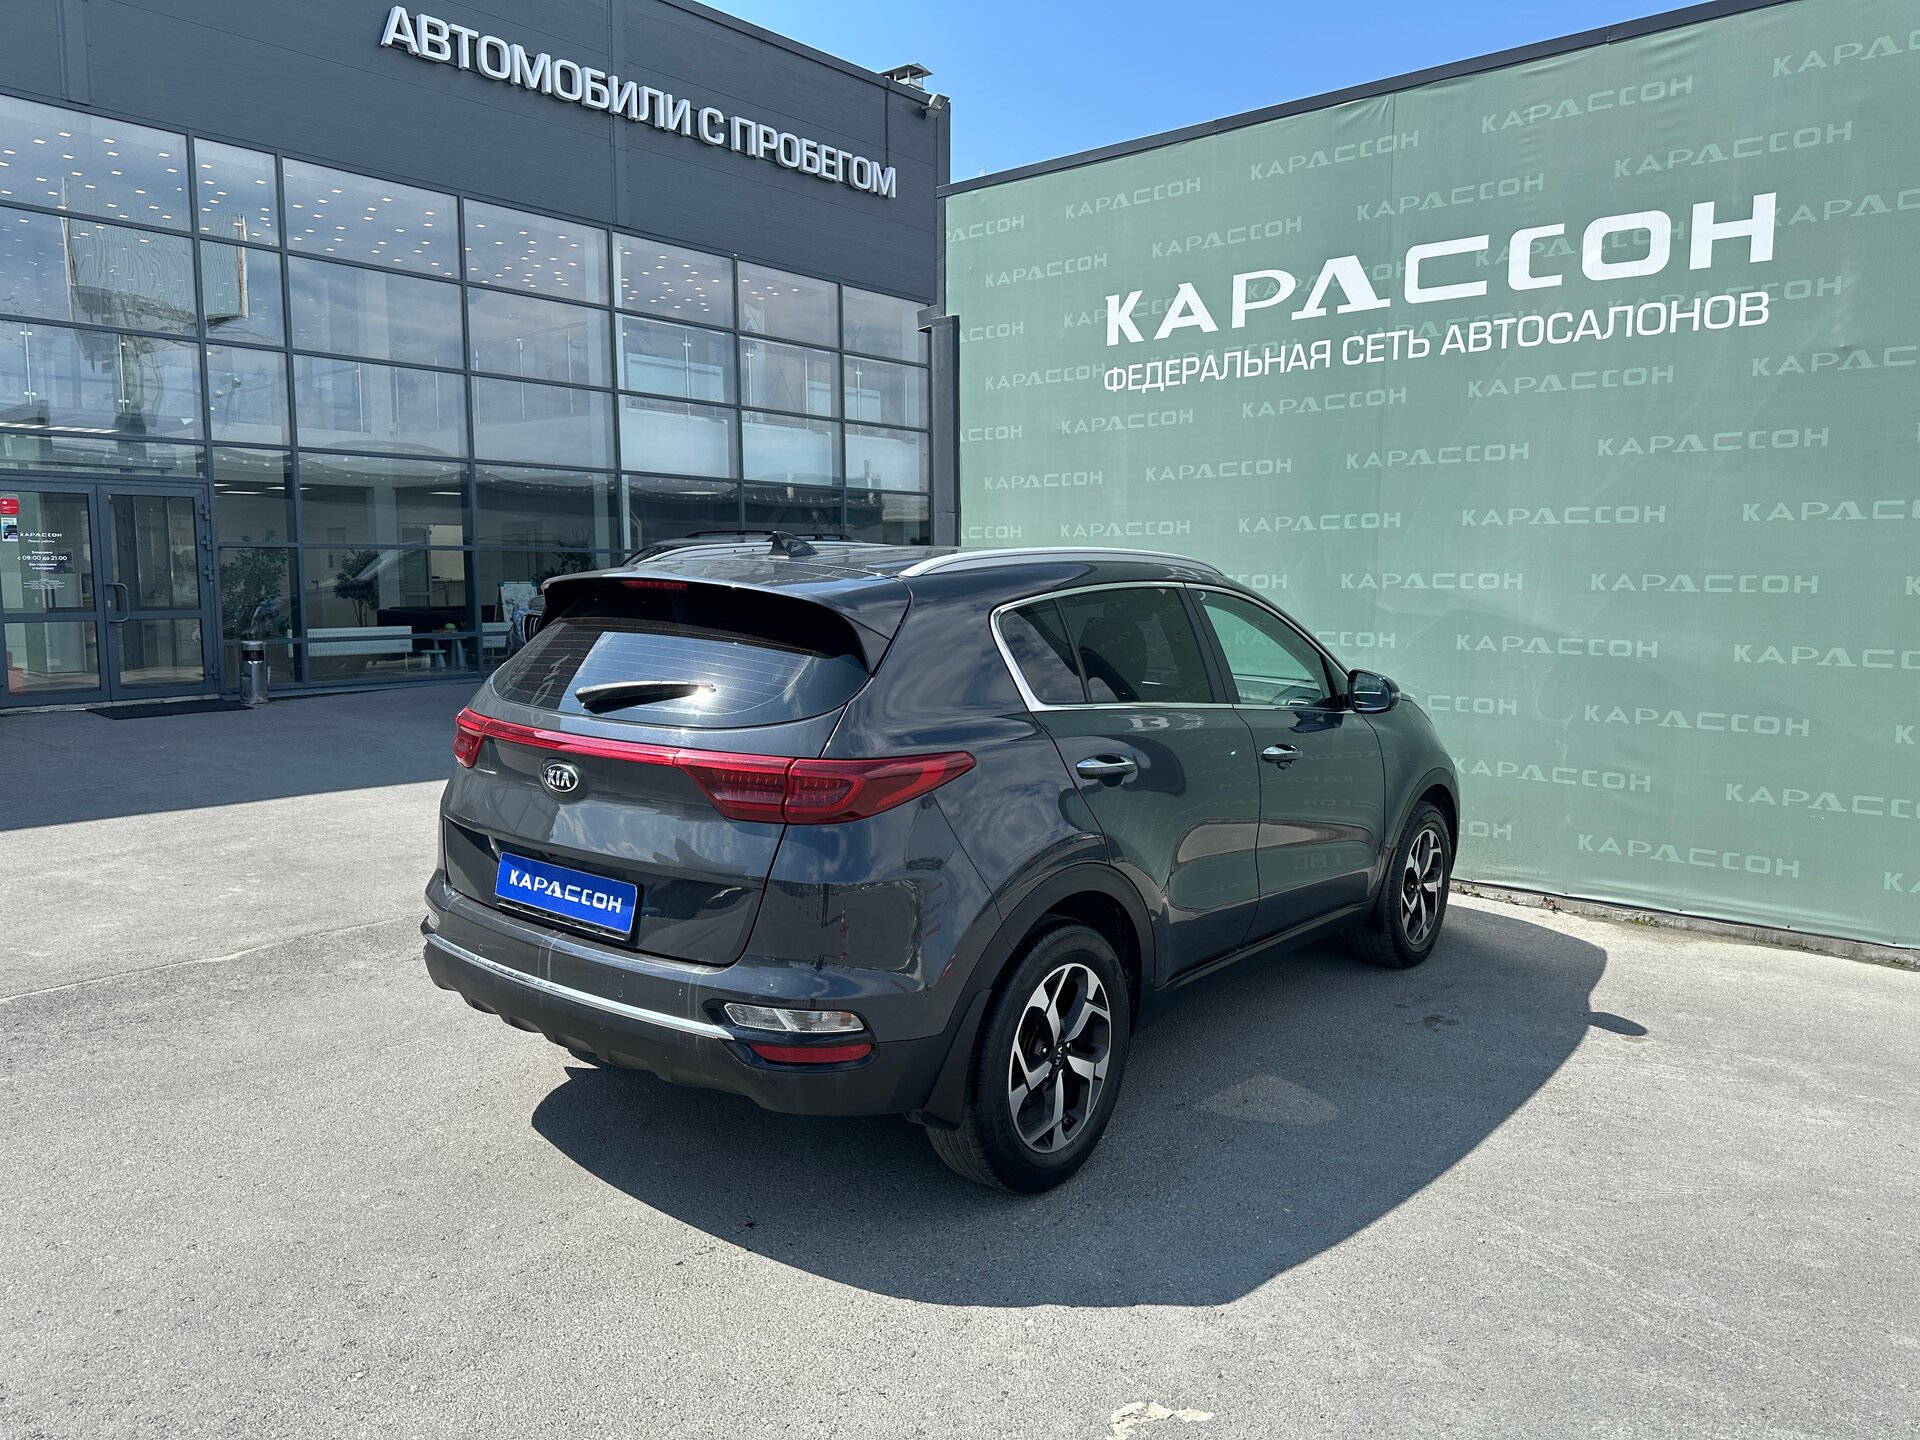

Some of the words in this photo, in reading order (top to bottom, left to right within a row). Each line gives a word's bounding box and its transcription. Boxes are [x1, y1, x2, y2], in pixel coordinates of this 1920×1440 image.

[380, 5, 691, 137] АВТОМОБИЛИ
[698, 108, 725, 145] С
[730, 116, 896, 198] ПРОБЕГОМ
[1103, 339, 1331, 393] ФЕДЕРАЛЬНАЯ
[1342, 328, 1430, 366] СЕТЬ
[1440, 291, 1770, 356] АВТОСАЛОНОВ
[547, 768, 571, 788] KIA
